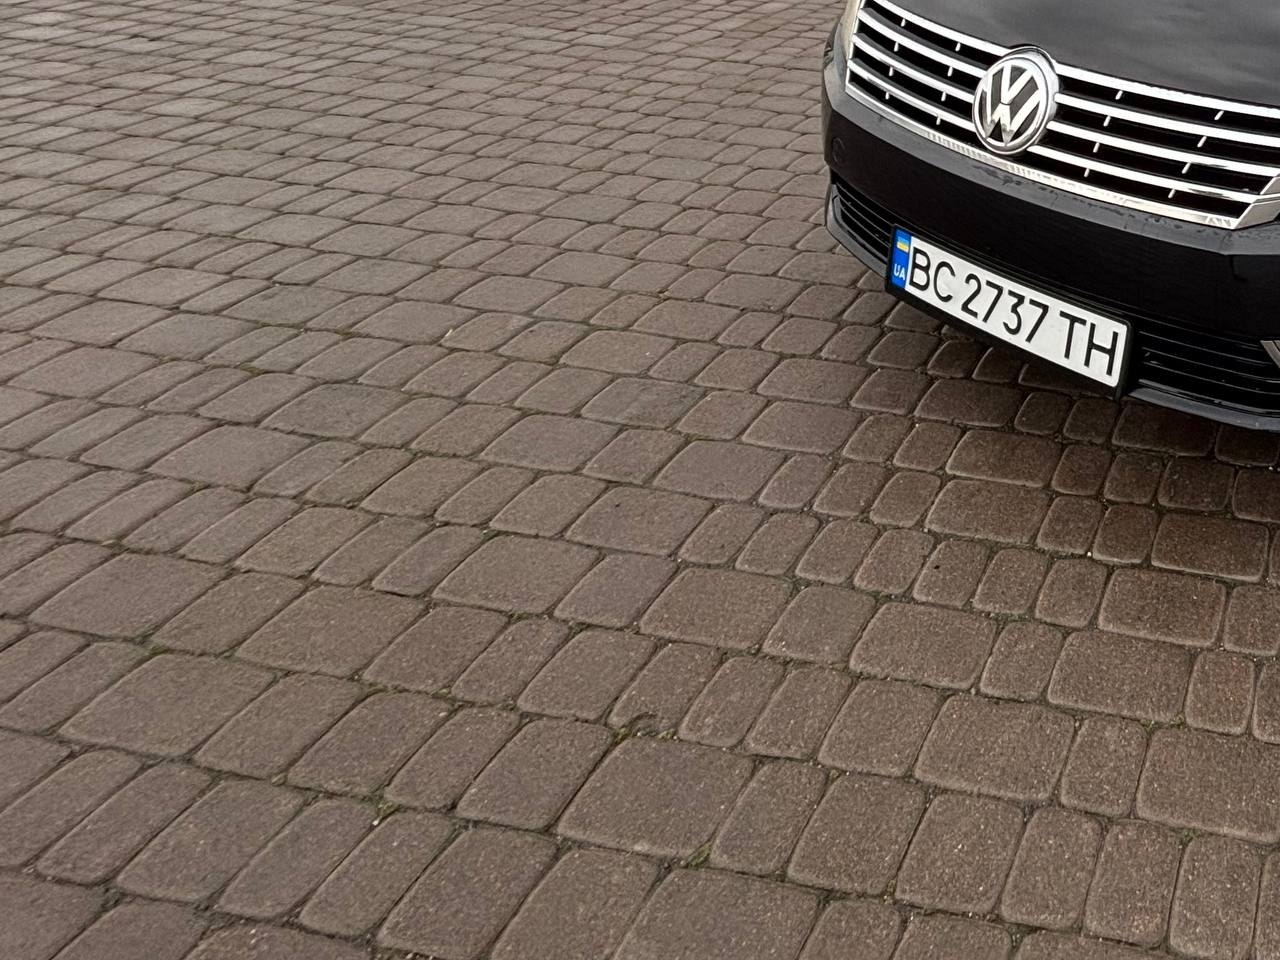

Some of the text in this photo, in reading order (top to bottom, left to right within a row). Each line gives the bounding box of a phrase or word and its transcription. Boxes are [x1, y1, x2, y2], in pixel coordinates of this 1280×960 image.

[893, 263, 905, 281] UA
[908, 246, 1119, 377] BC 2737 TH
